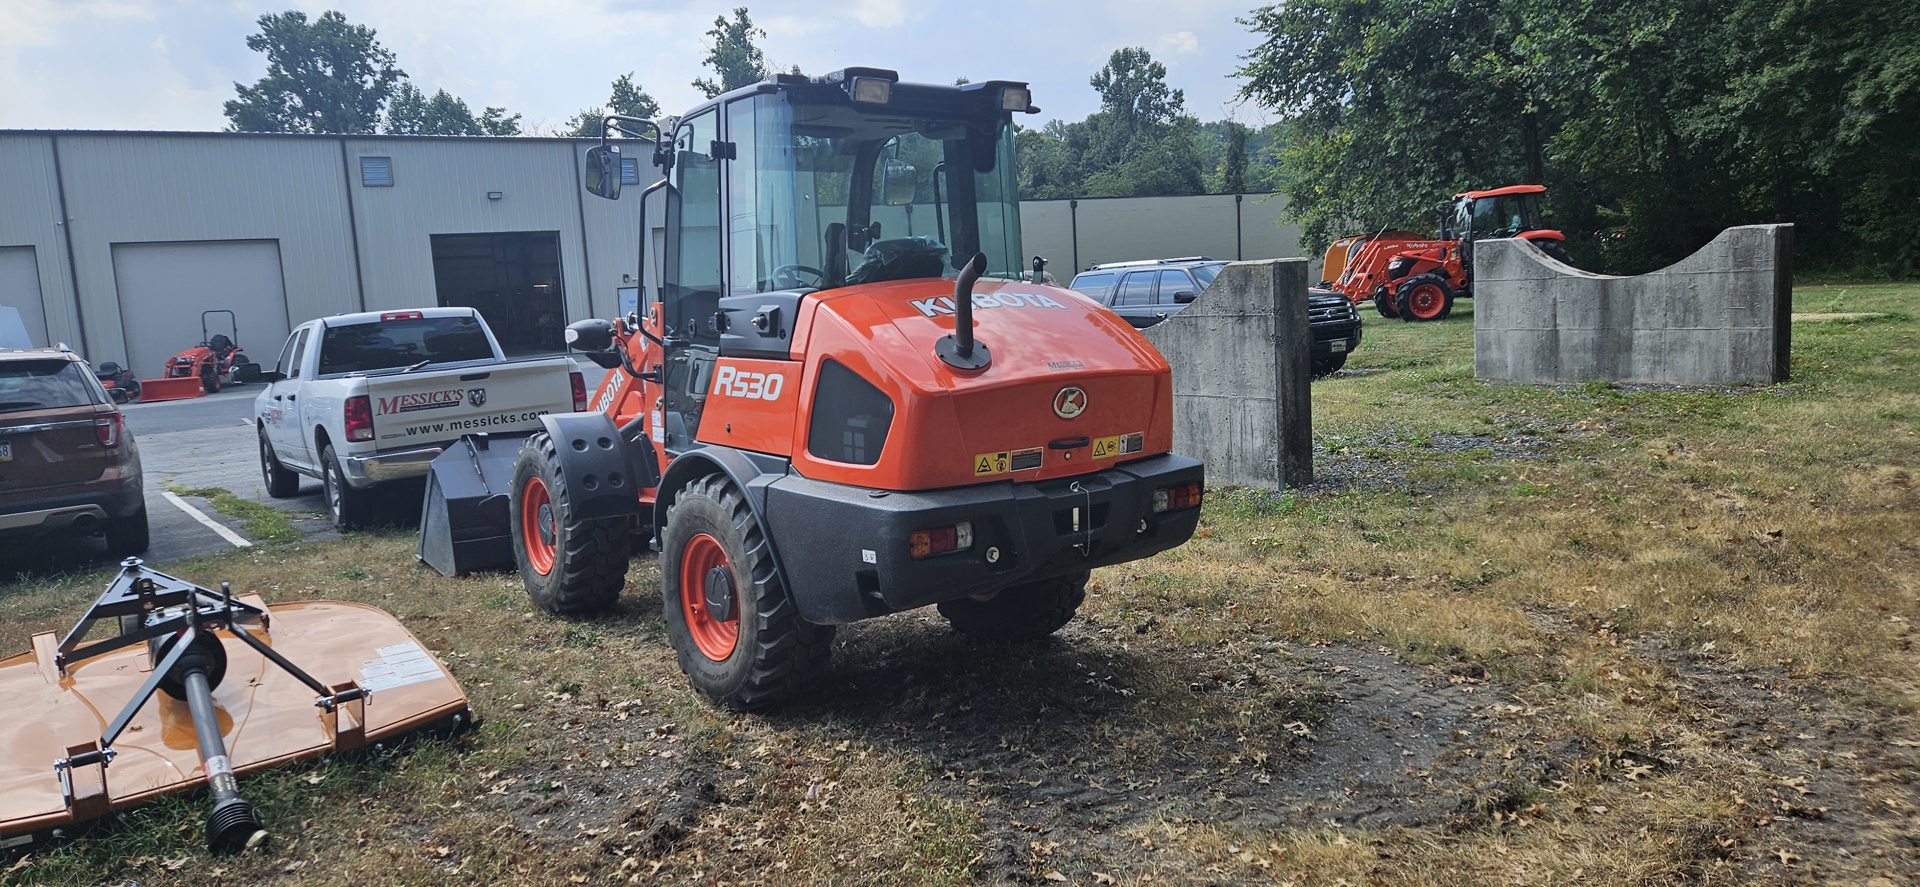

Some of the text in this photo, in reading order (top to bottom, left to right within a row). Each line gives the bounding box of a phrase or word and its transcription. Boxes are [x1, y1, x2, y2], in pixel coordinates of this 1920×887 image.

[594, 367, 624, 412] UBOTA
[713, 365, 784, 401] R530
[376, 389, 464, 416] MESSICK'S
